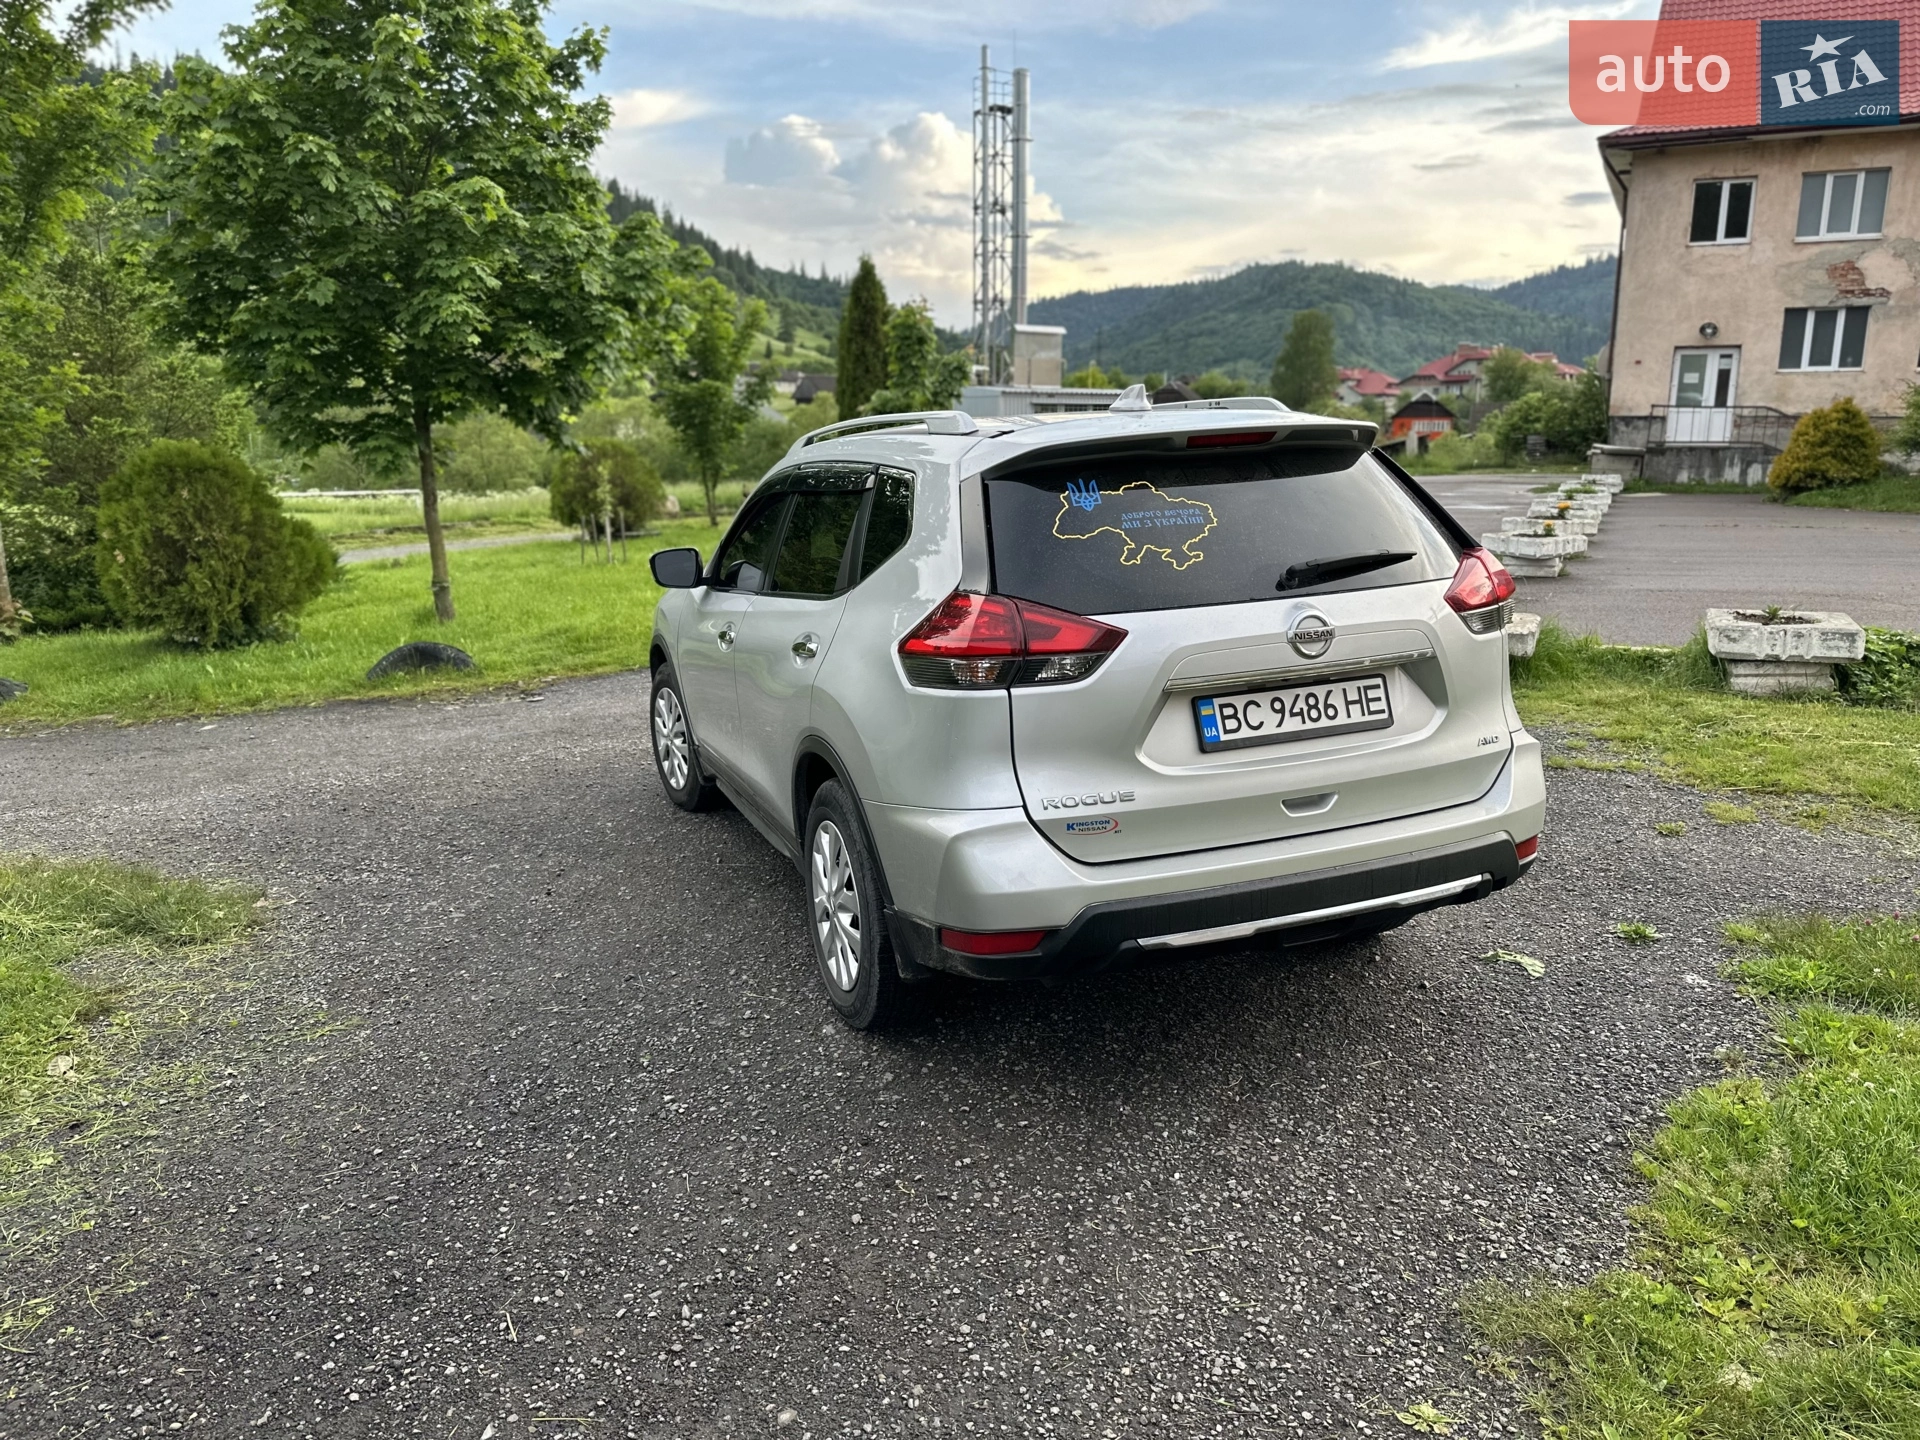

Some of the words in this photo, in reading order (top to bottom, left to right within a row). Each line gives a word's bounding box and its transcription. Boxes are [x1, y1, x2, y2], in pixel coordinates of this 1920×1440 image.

[1121, 510, 1161, 521] ДОБРОГО
[1121, 520, 1141, 529] МИ
[1293, 628, 1333, 642] NISSAN
[1217, 699, 1265, 735] BC
[1270, 689, 1339, 728] 9486
[1342, 684, 1387, 719] HE
[1204, 726, 1219, 738] UA
[1477, 735, 1500, 747] AWD
[1041, 789, 1136, 811] ROGUE
[1066, 819, 1111, 832] KINGSTON
[1078, 825, 1108, 833] NISSAN
